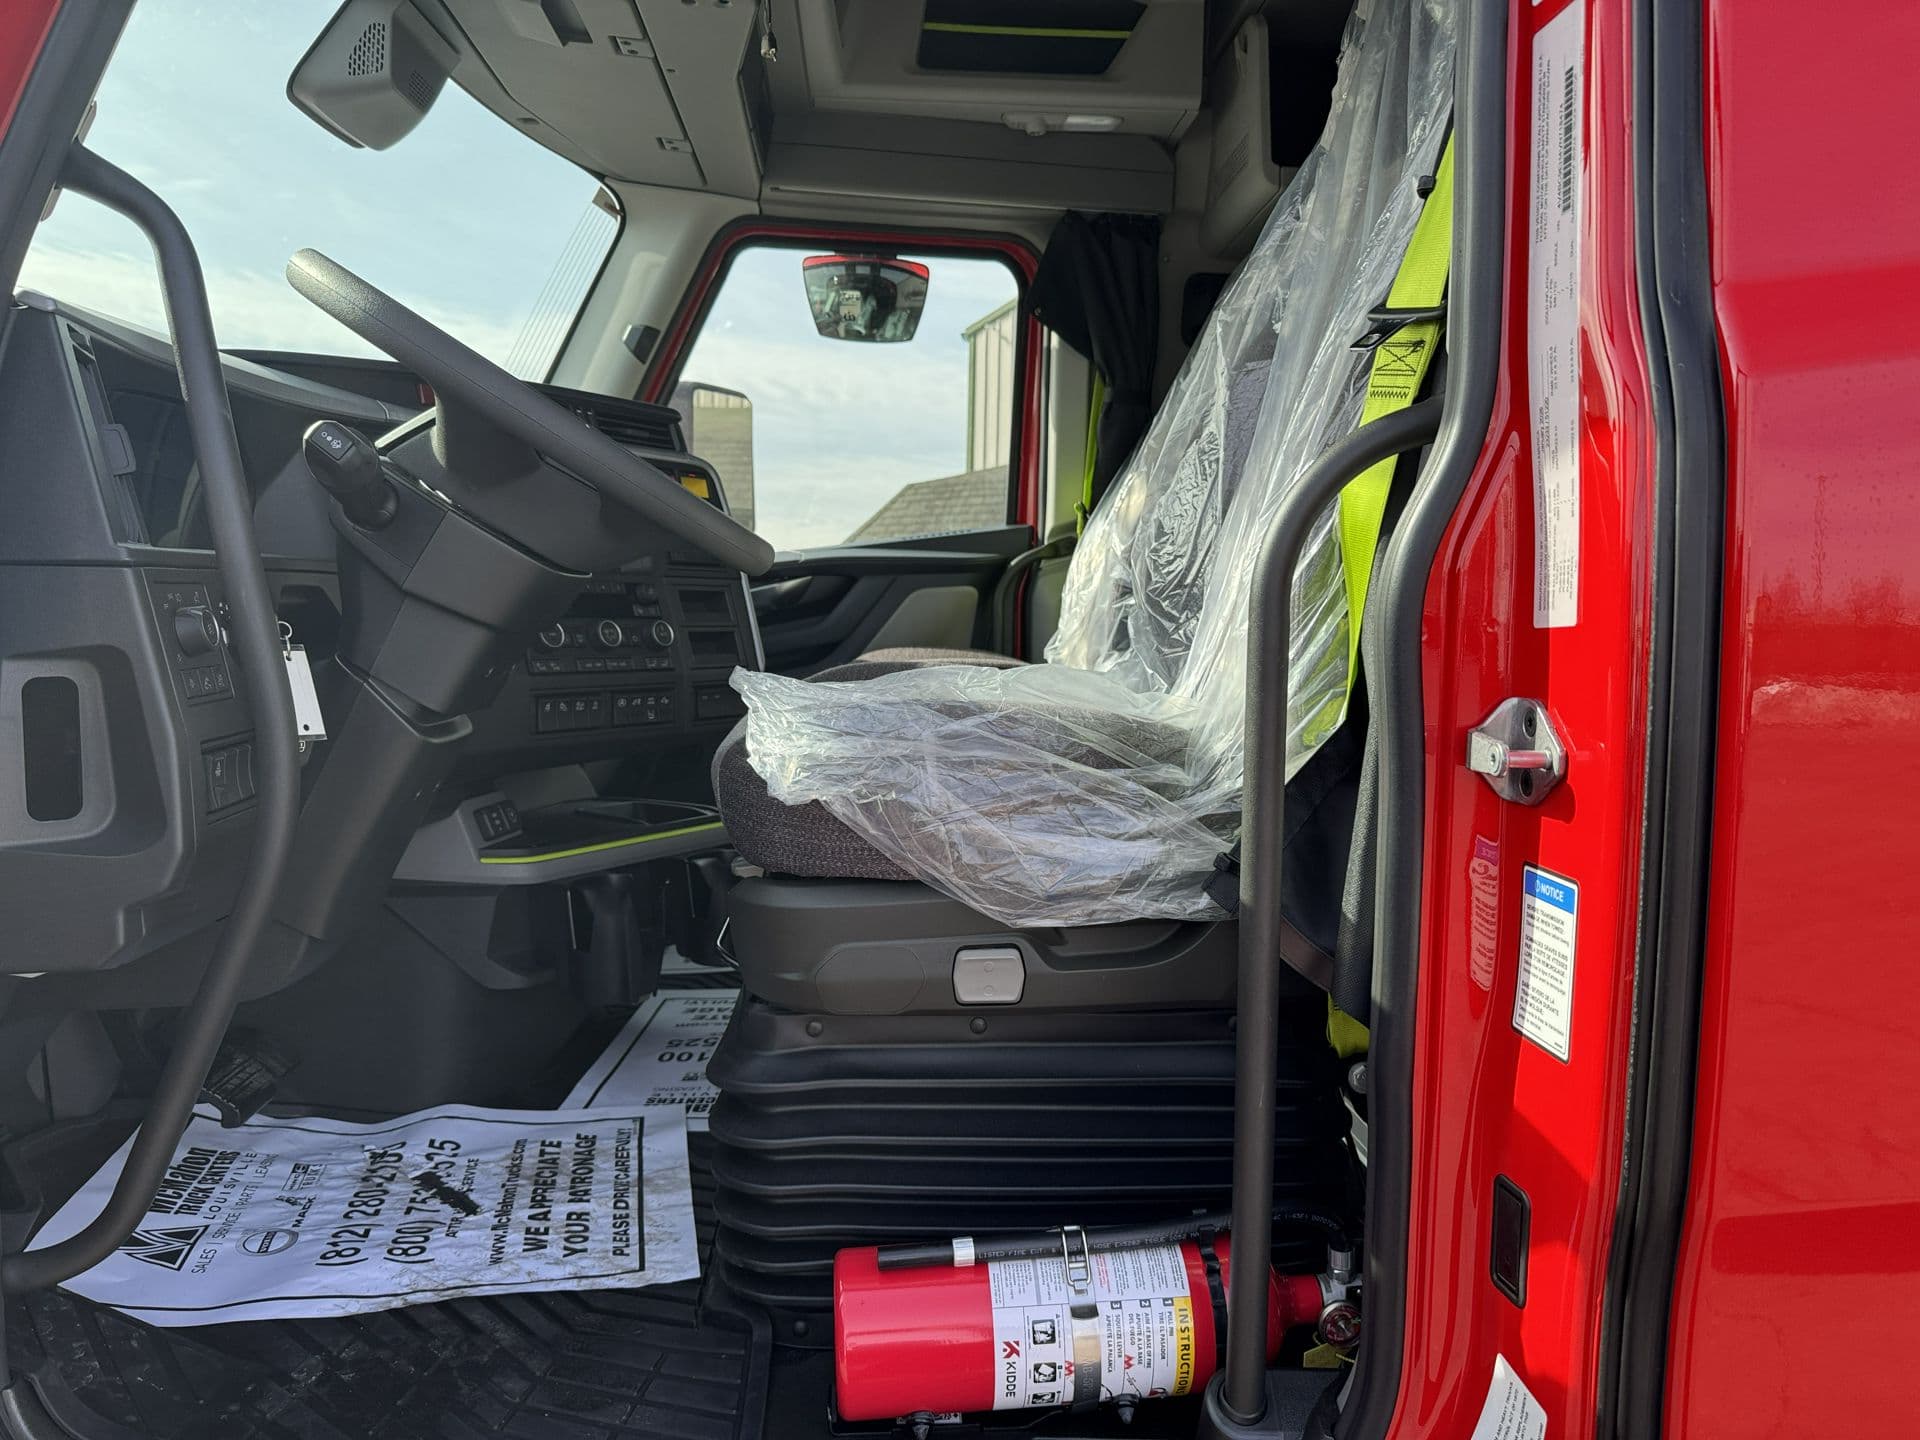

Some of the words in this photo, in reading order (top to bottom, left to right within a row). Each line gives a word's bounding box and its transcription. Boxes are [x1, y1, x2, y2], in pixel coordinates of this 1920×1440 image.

[1540, 881, 1565, 903] NOTICE
[657, 1051, 709, 1062] 100
[174, 1186, 215, 1215] TRUCK
[197, 1150, 240, 1185] CENTERS
[203, 1152, 258, 1220] LOUISVILLE
[528, 1139, 562, 1222] APPRECIATE
[567, 1133, 597, 1203] PATRONAGE
[292, 1195, 317, 1228] MACK
[613, 1179, 630, 1211] DRIVE
[191, 1249, 217, 1274] SALES
[212, 1212, 241, 1239] SERVICE
[236, 1185, 259, 1209] PARTS
[315, 1224, 384, 1266] (812)
[384, 1221, 447, 1264] (800)
[522, 1226, 550, 1253] WE
[563, 1211, 590, 1258] YOUR
[612, 1212, 630, 1257] PLEASE
[1005, 1361, 1017, 1398] KIDDE
